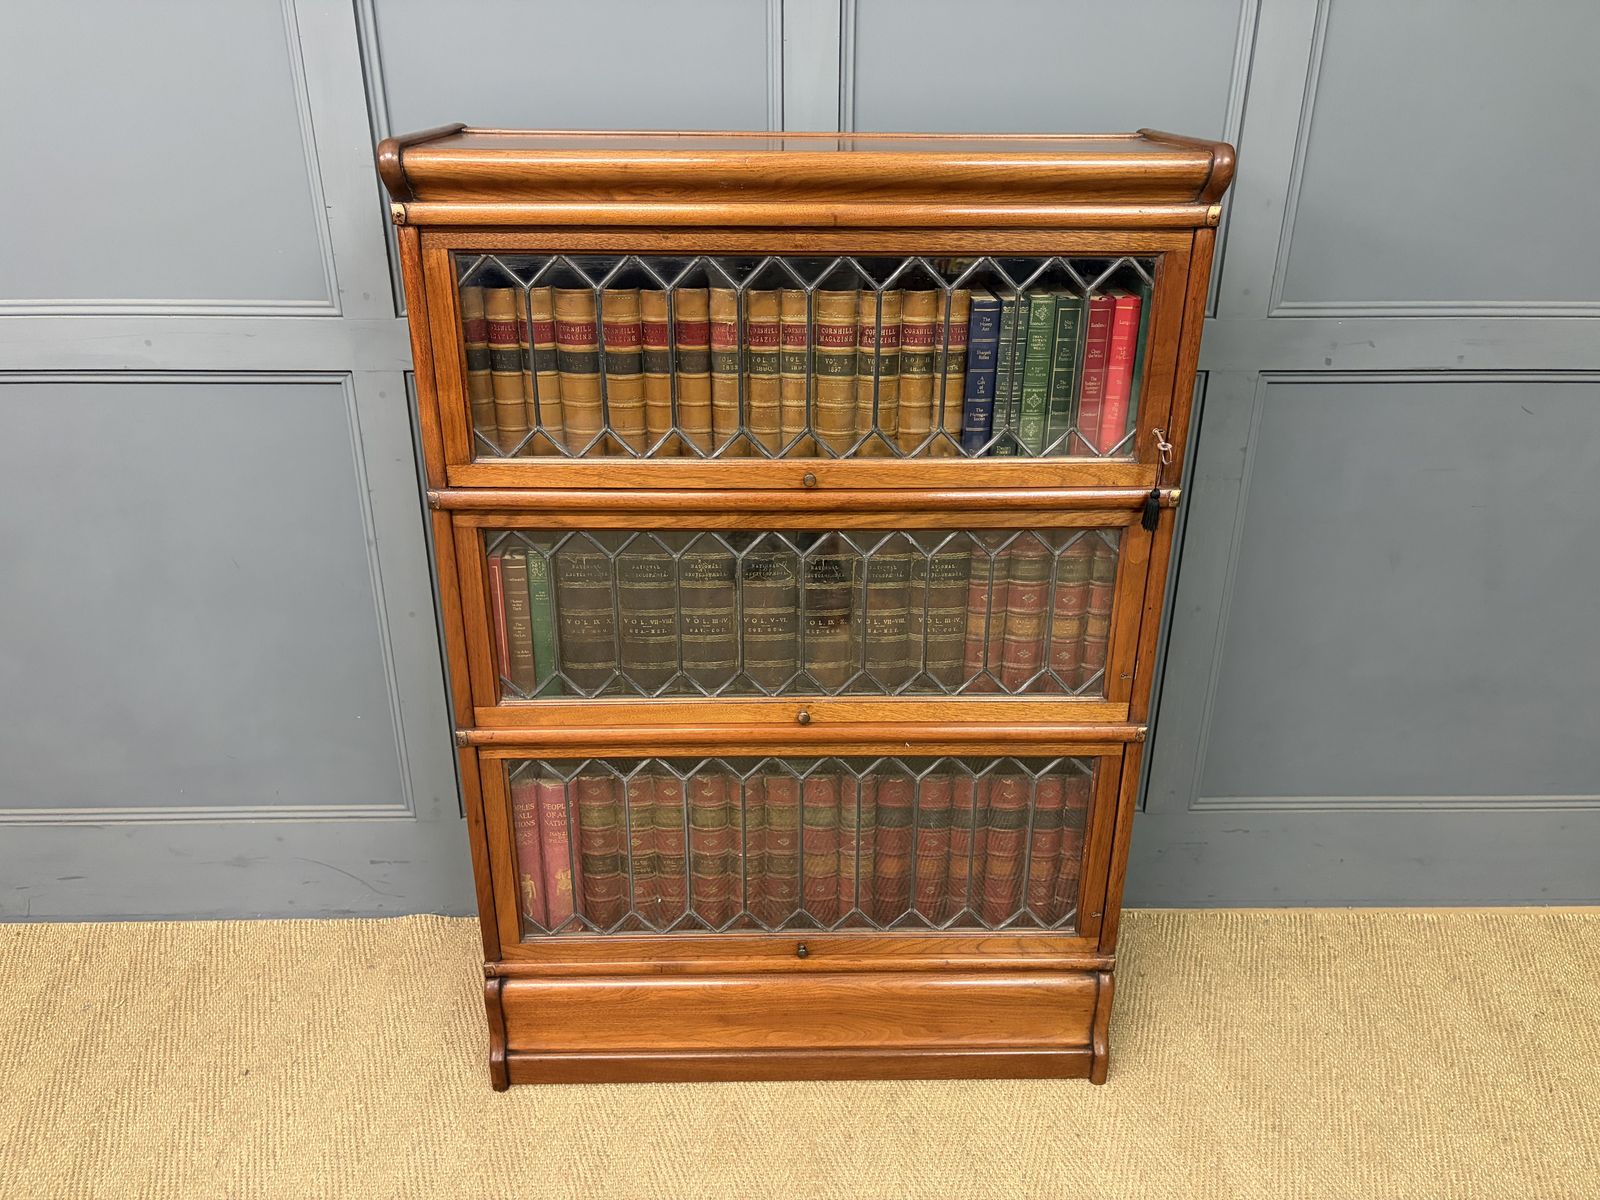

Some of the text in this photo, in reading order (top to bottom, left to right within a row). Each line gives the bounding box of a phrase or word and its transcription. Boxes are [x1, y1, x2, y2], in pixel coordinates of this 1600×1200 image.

[865, 328, 896, 336] CORHILL
[820, 335, 853, 343] MAGAZINE
[863, 336, 897, 344] MAGZINE
[543, 800, 574, 811] PEOPLS
[544, 817, 575, 827] NATIOS
